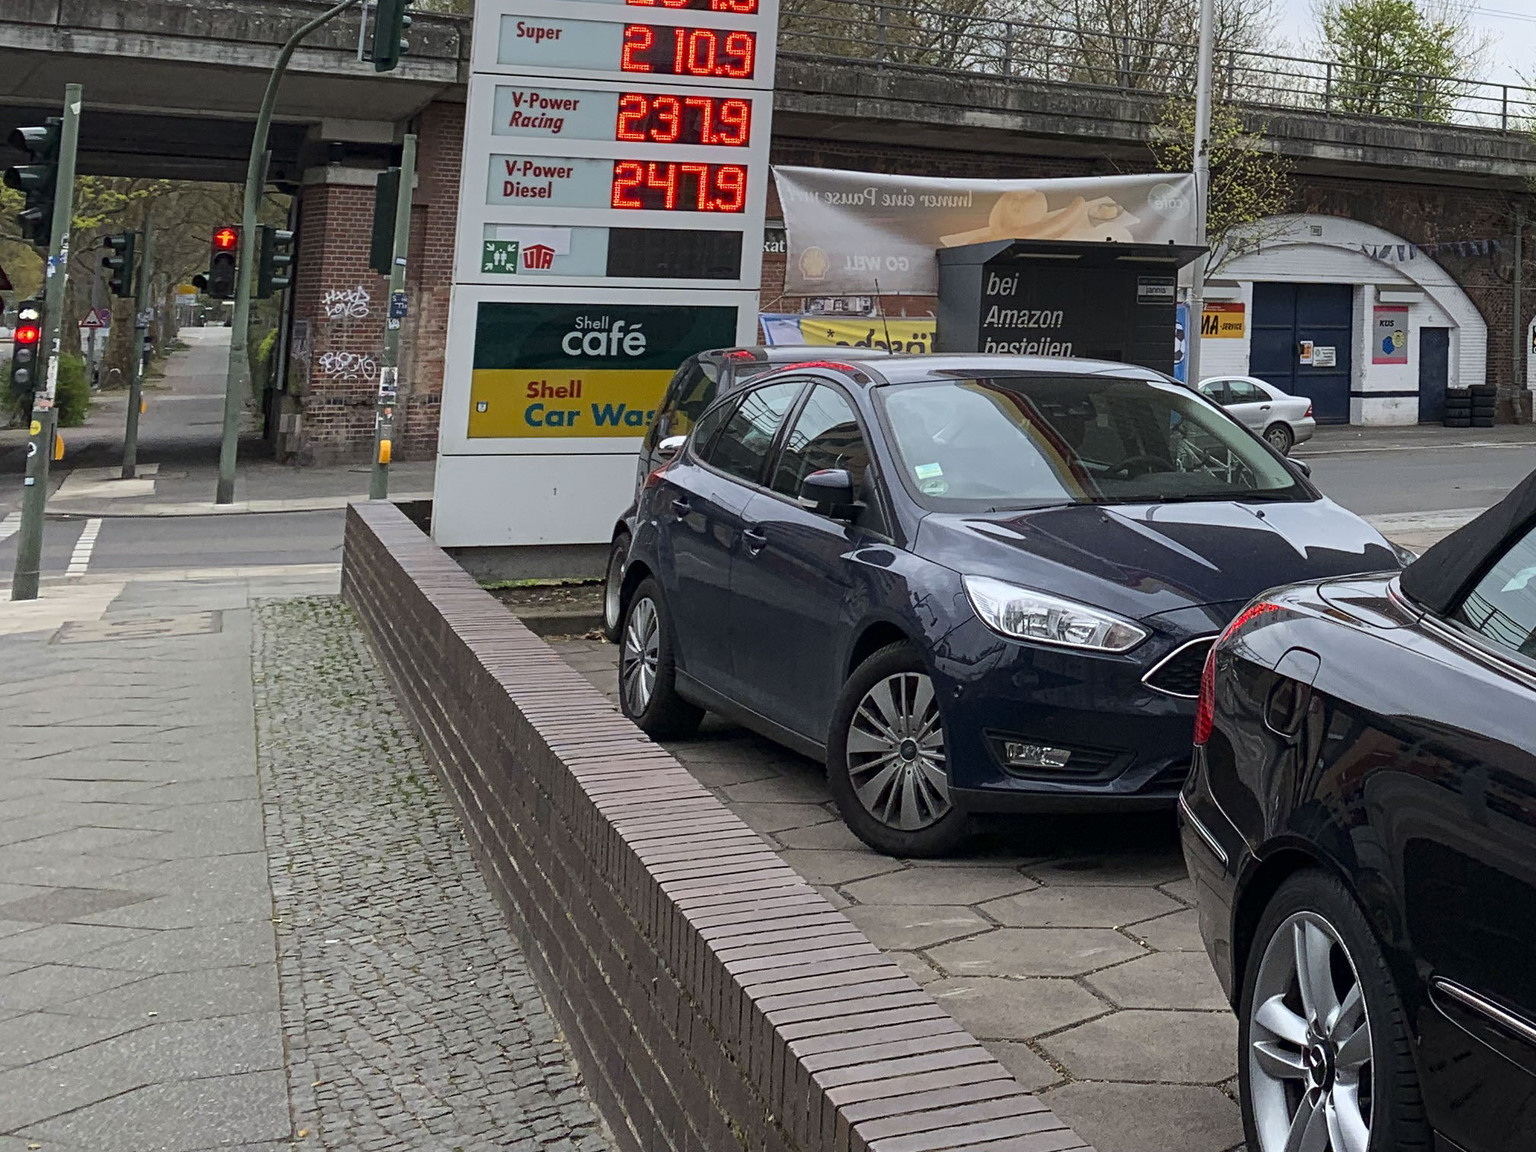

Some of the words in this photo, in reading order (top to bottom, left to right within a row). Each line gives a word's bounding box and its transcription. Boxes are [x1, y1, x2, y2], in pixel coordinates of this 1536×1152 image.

[516, 21, 562, 41] Super
[511, 91, 580, 111] V-Power
[508, 111, 564, 134] Racing
[505, 159, 574, 179] V-Power
[502, 180, 553, 200] Diesel
[986, 272, 1020, 296] bei
[575, 315, 610, 330] Shell
[983, 305, 1064, 328] Amazon
[561, 320, 647, 357] café
[526, 380, 583, 399] Shell
[524, 403, 581, 427] Car
[591, 403, 655, 427] Was
